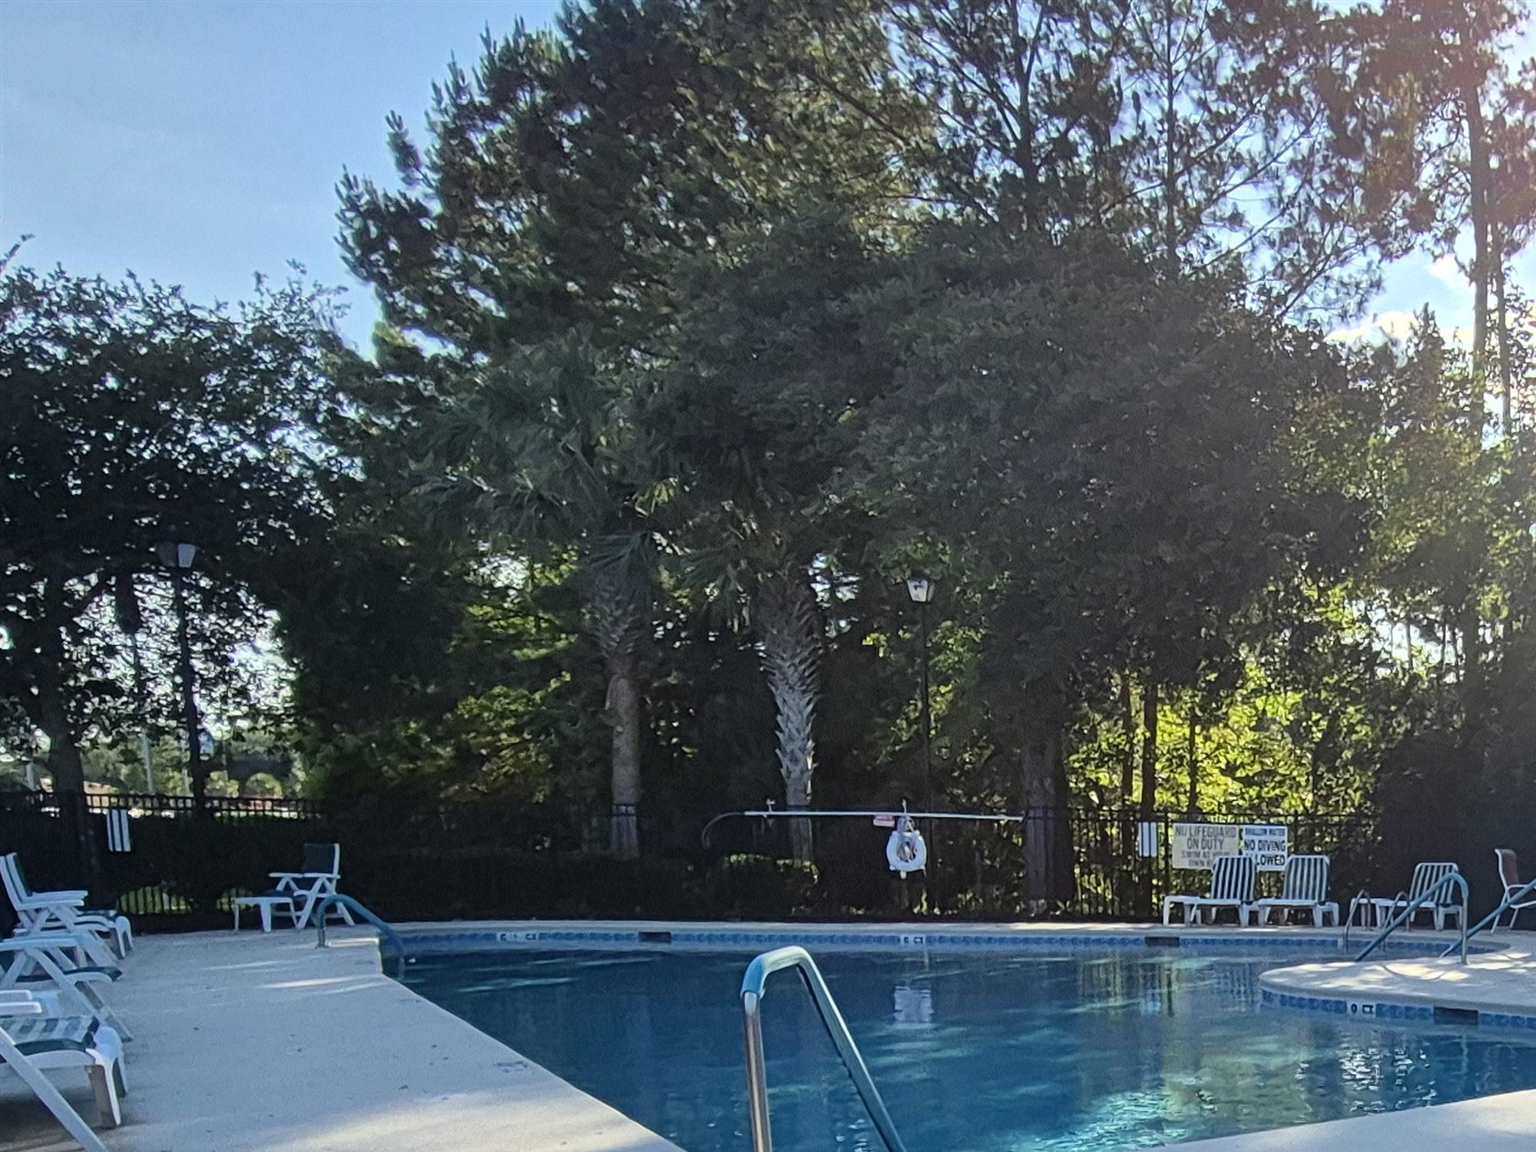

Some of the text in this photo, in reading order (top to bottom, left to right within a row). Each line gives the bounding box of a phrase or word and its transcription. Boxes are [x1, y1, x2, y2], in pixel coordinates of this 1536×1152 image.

[1175, 825, 1236, 838] NO LIFEGUARD
[1187, 838, 1224, 850] ON DUTY
[1244, 840, 1286, 851] NO DIVING
[1254, 854, 1286, 866] LOWED
